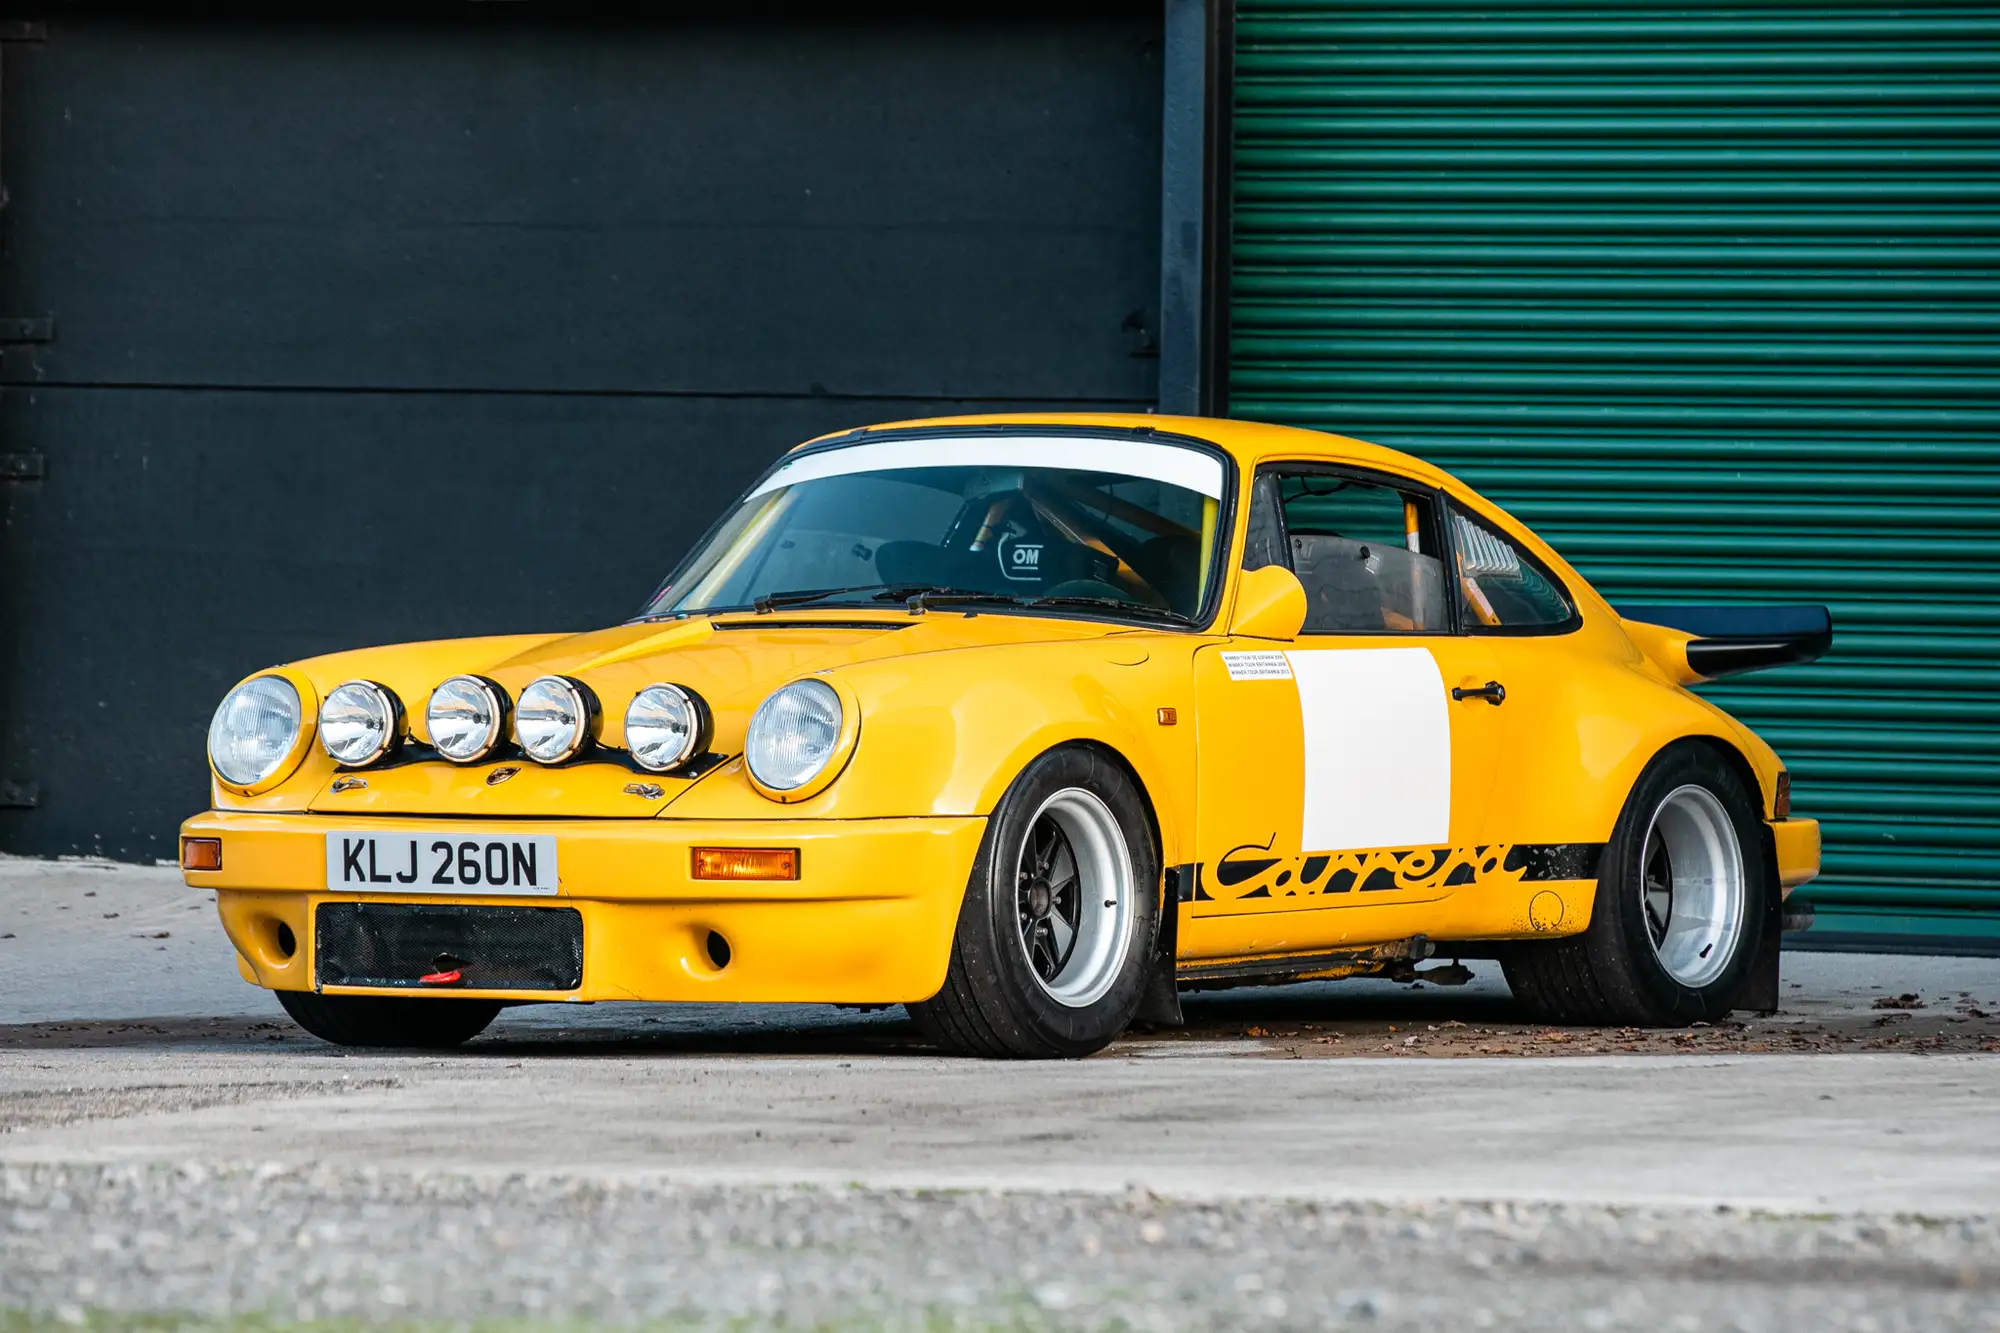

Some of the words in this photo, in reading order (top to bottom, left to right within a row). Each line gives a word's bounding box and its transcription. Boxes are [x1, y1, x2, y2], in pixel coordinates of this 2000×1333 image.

[343, 838, 418, 883] KLJ
[431, 841, 537, 886] 260N
[1200, 832, 1529, 900] Carrera
